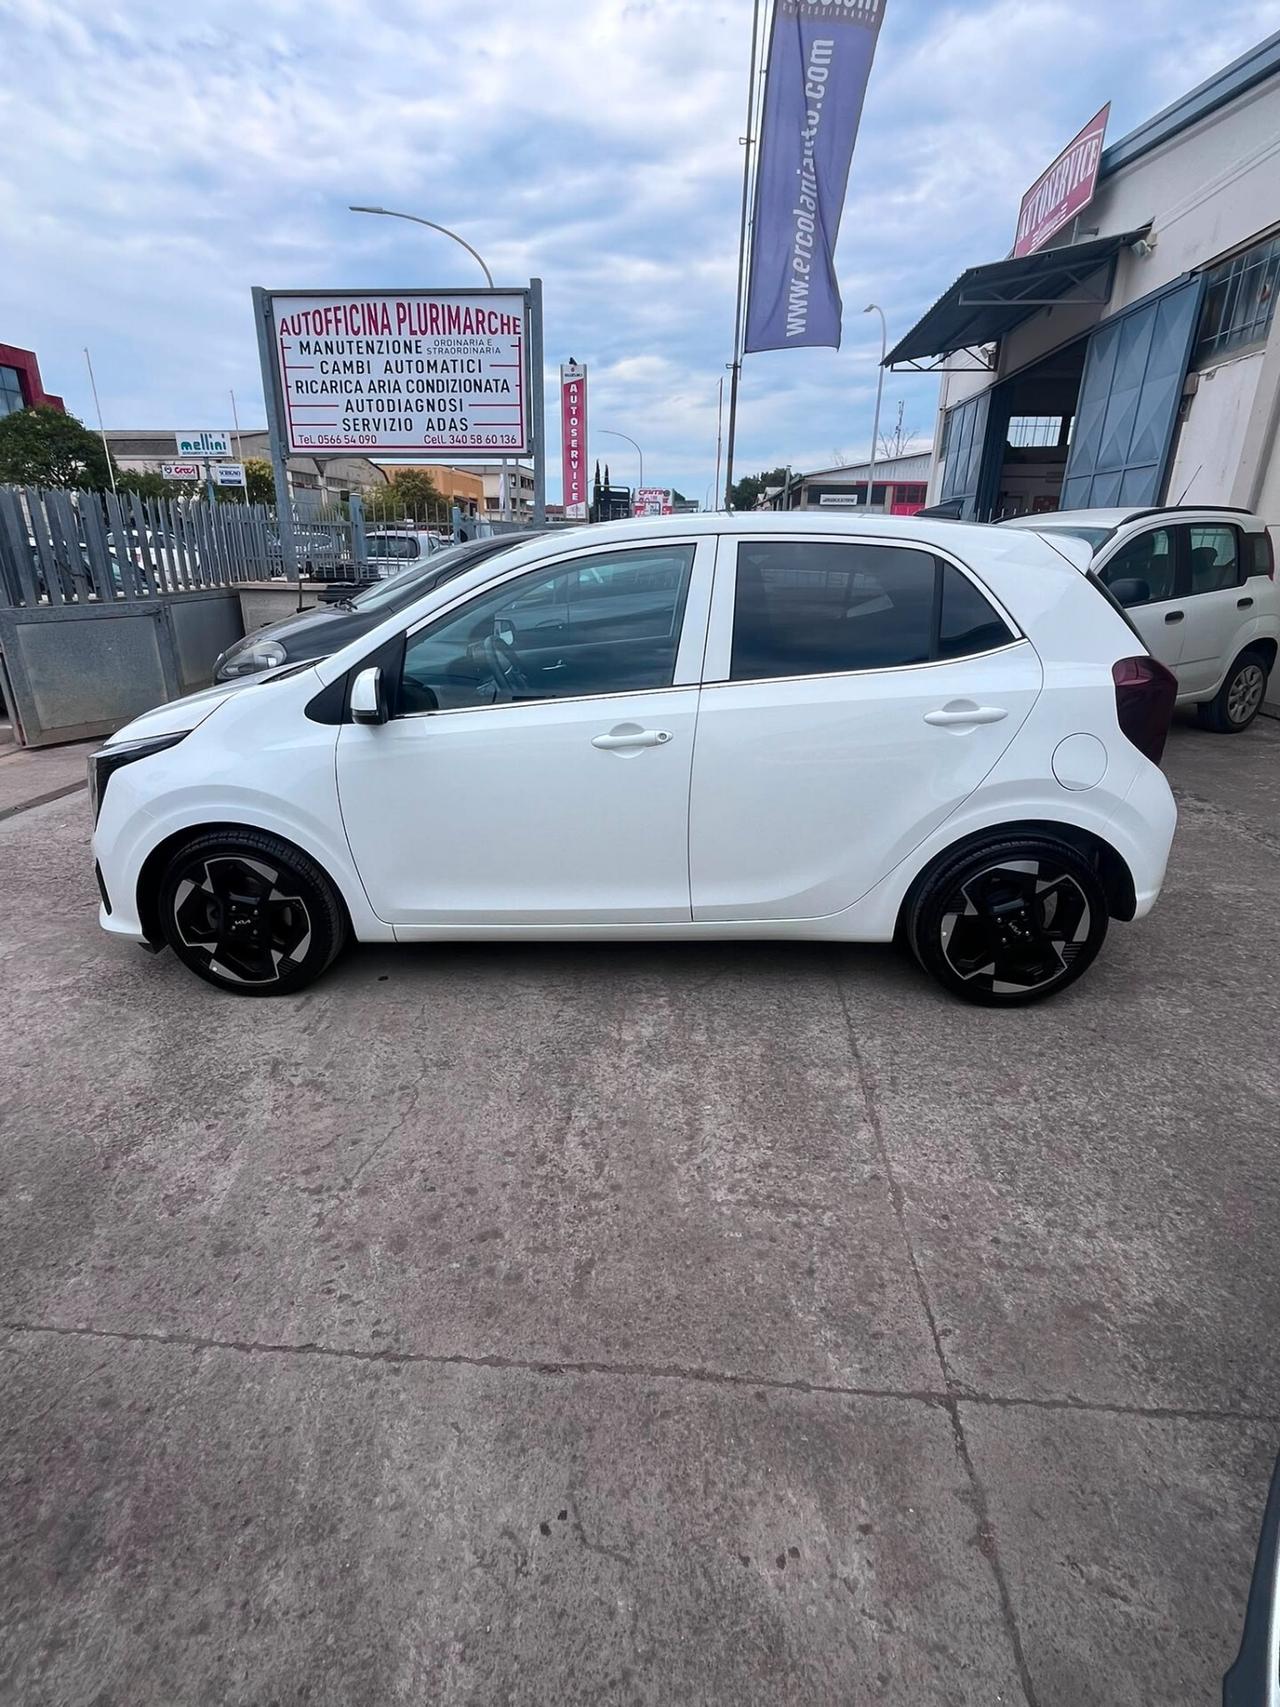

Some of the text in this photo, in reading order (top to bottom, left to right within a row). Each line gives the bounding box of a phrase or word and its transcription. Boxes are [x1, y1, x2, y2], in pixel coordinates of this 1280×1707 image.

[280, 302, 521, 336] AUTOFFICINA PLURIMARCHE
[299, 339, 422, 356] MANUTENZIONE
[433, 339, 493, 347] ORDINARIA E
[426, 347, 501, 355] STRAORDINARIA
[320, 359, 482, 375] CAMBI AUTOMATICI
[295, 378, 510, 394] RICARICA ARIA CONDIZIONATA
[345, 398, 463, 413] AUTODIAGNOSI
[343, 417, 469, 432] SERVIZIO ADAS
[180, 433, 227, 451] mellini
[298, 434, 377, 444] Tel. 0566 54 090
[423, 434, 517, 445] Cell. 340 58 60 136
[569, 383, 578, 501] AUTOSERVICE
